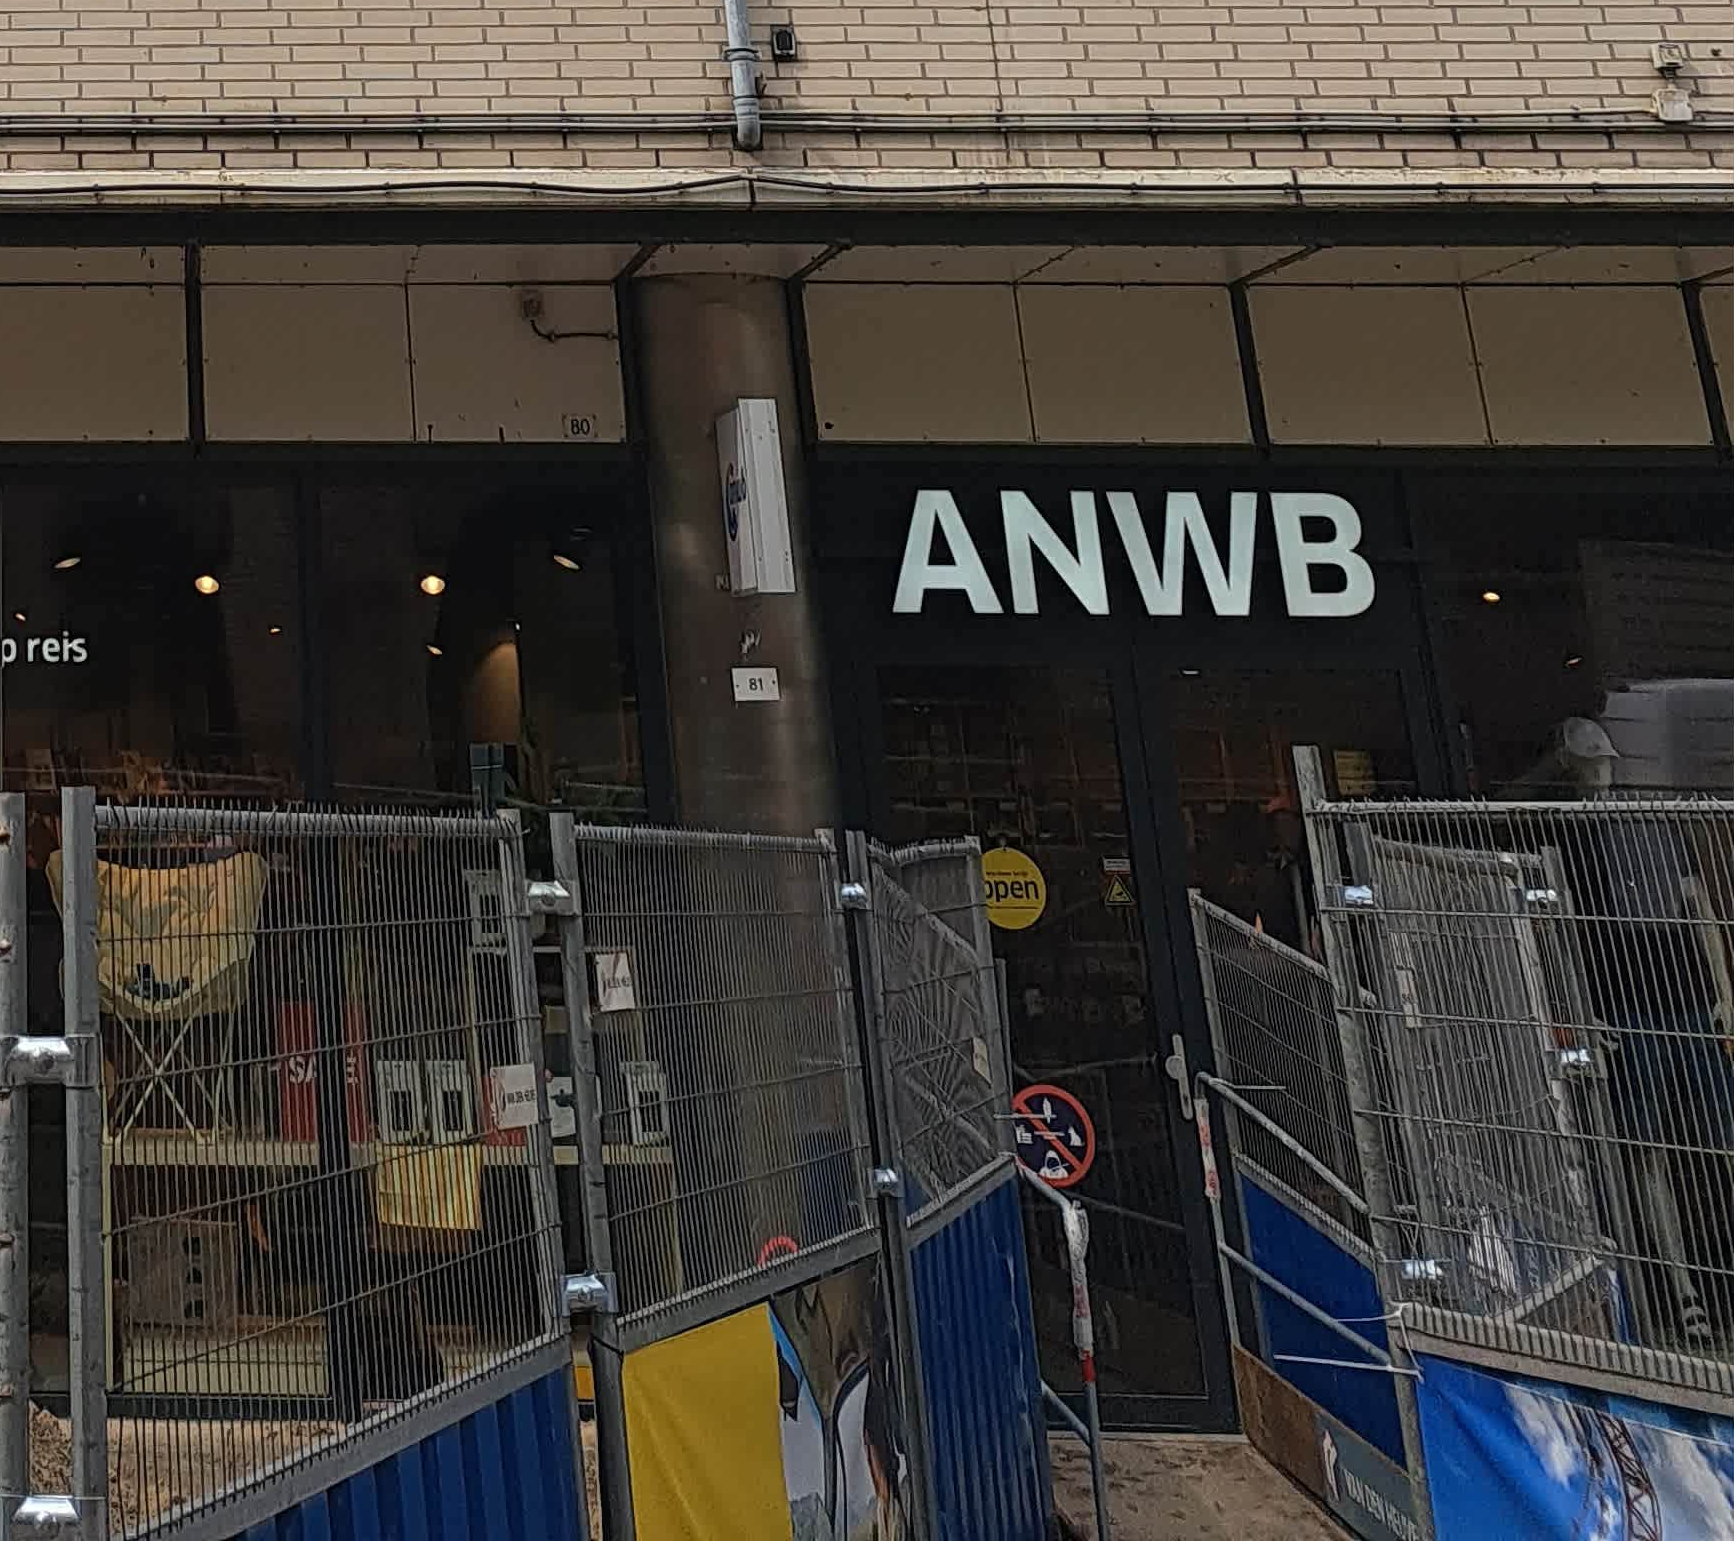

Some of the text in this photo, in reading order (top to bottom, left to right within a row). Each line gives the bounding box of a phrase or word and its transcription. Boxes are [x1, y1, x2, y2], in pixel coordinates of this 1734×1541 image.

[571, 419, 591, 435] 80
[892, 489, 1375, 617] ANWB
[26, 630, 88, 663] reis
[749, 677, 764, 692] 81
